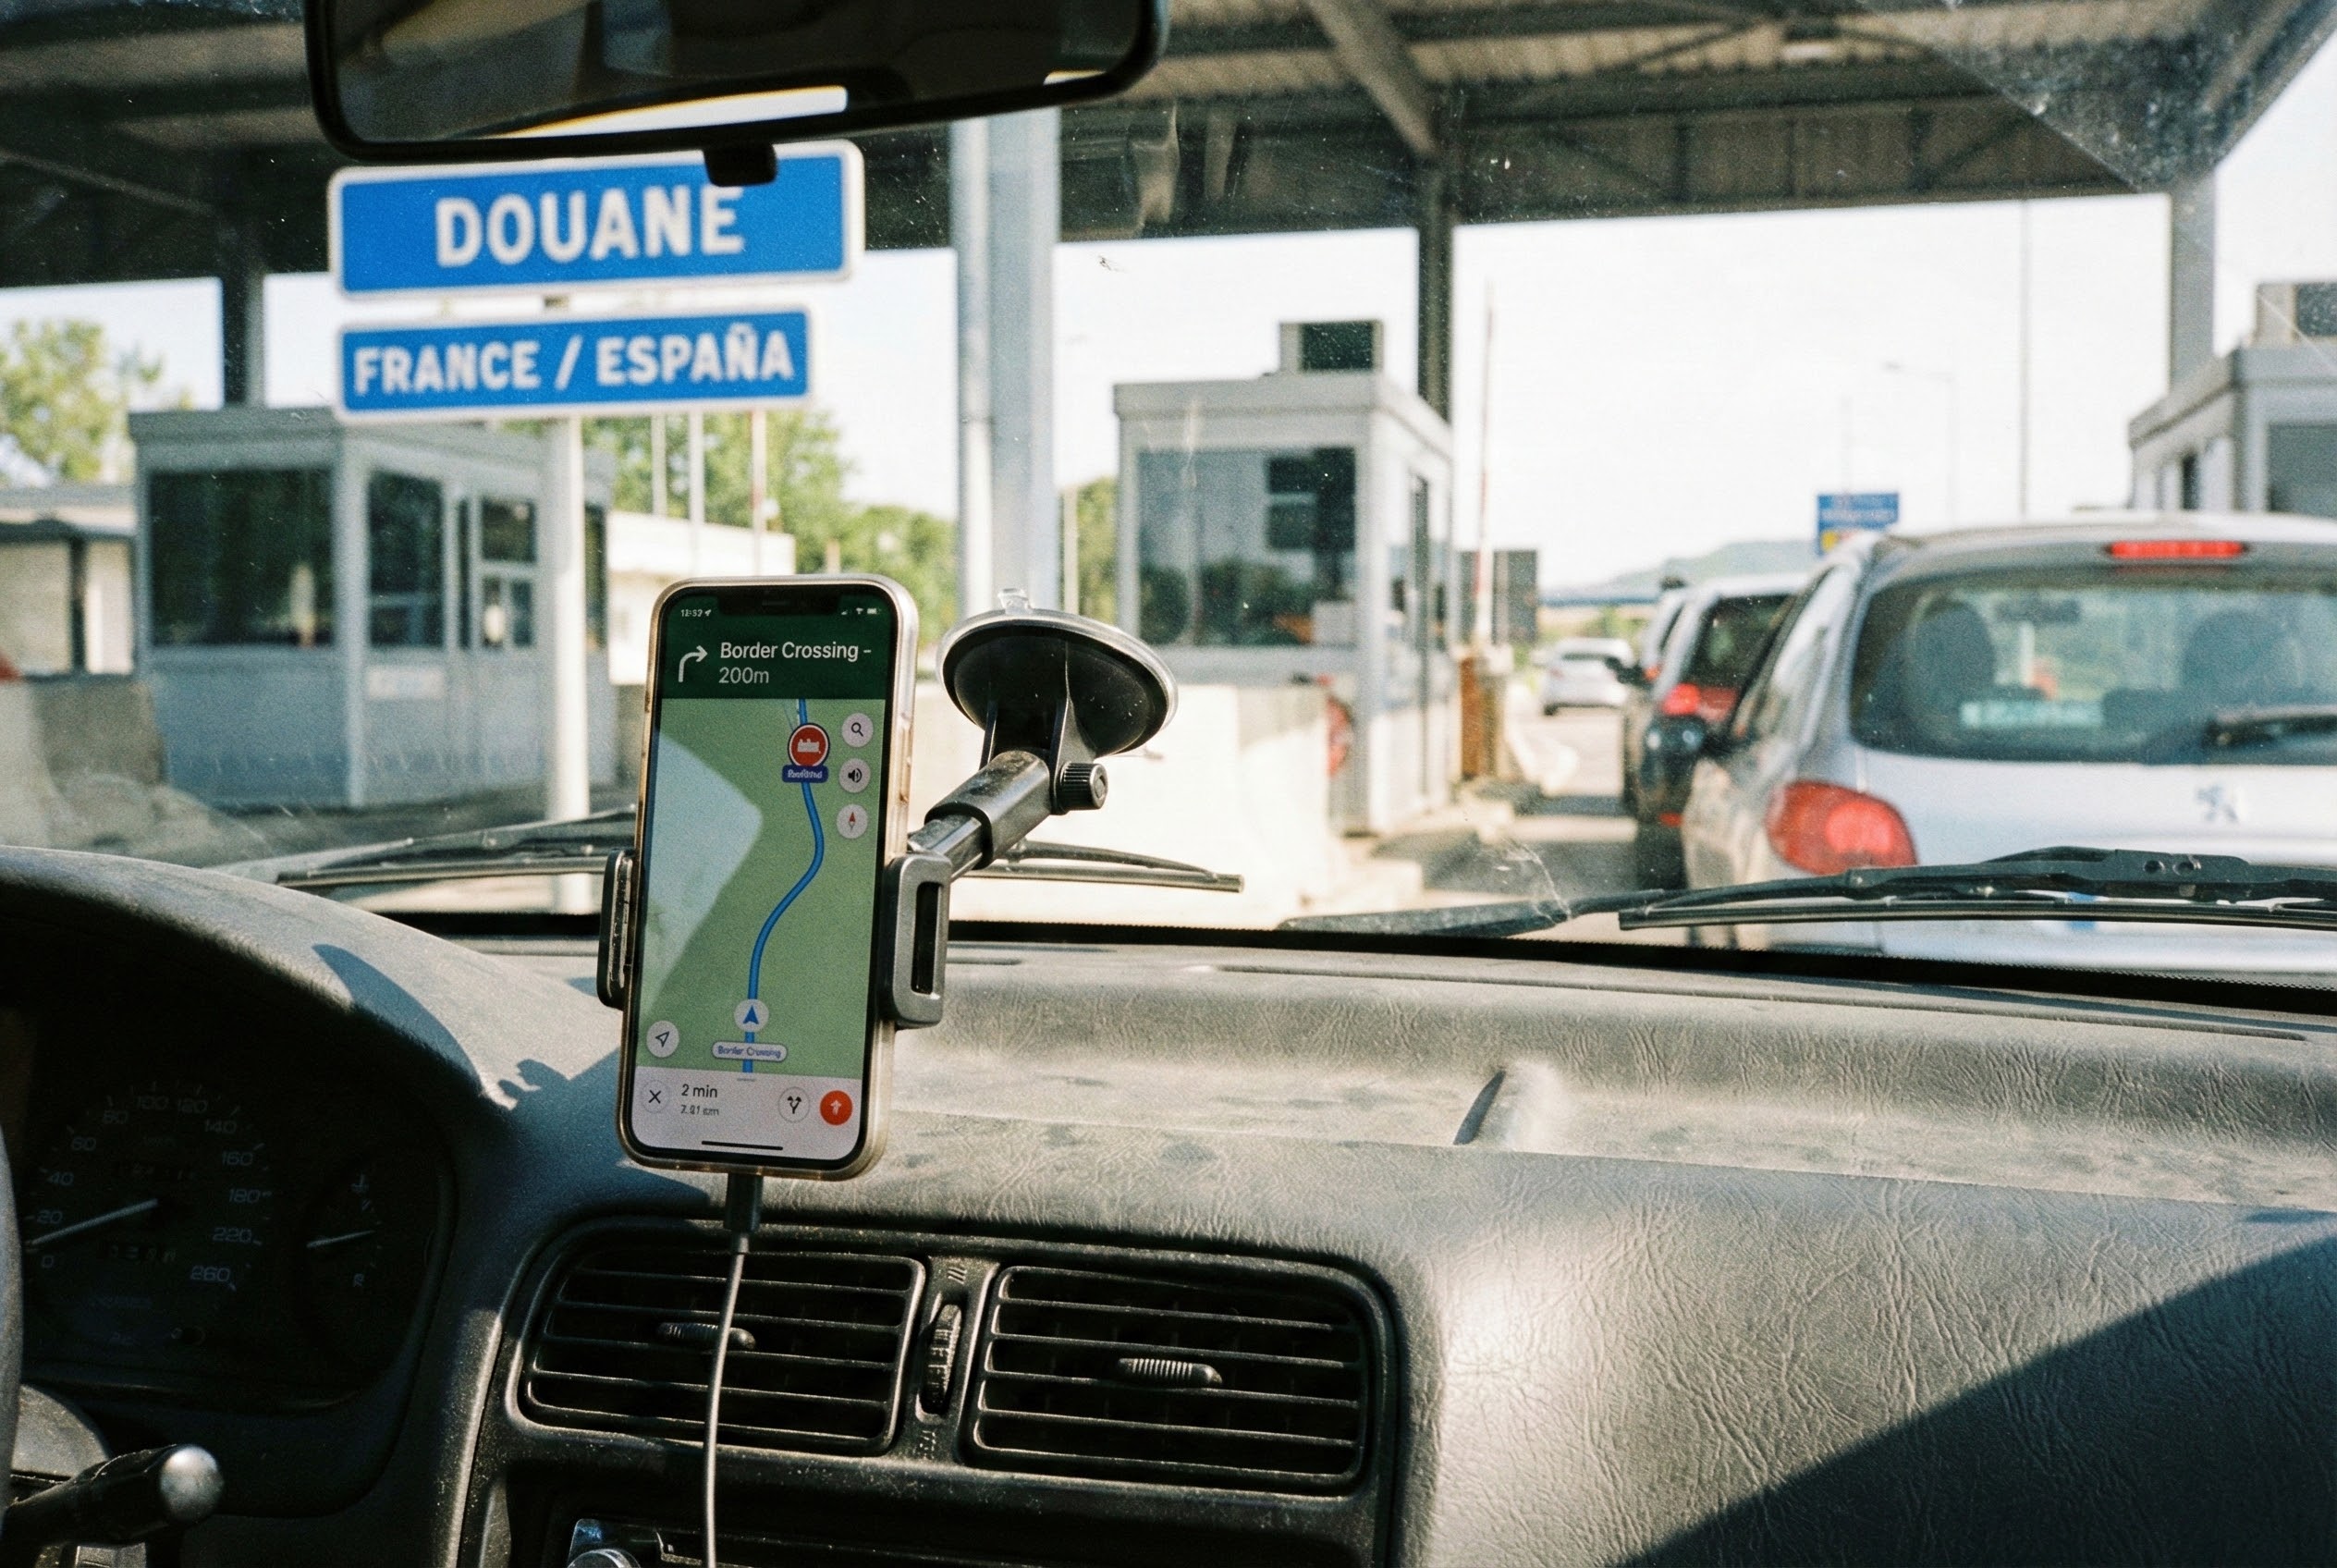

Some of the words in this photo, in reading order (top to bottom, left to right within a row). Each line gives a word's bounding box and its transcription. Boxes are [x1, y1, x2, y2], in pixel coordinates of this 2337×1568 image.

[435, 185, 746, 268] DOUANE
[353, 339, 541, 397] FRANCE
[555, 335, 583, 391] /
[596, 323, 794, 387] ESPAÑA
[720, 641, 777, 659] Border
[782, 641, 859, 663] Crossing
[718, 667, 770, 684] 200m
[681, 1084, 690, 1096] 2
[692, 1084, 718, 1098] min
[204, 1120, 237, 1134] 140
[221, 1151, 254, 1166] 160
[47, 1171, 74, 1186] 40
[228, 1189, 261, 1205] 180
[37, 1209, 63, 1225] 20
[212, 1227, 252, 1243] 220
[190, 1266, 232, 1282] 260
